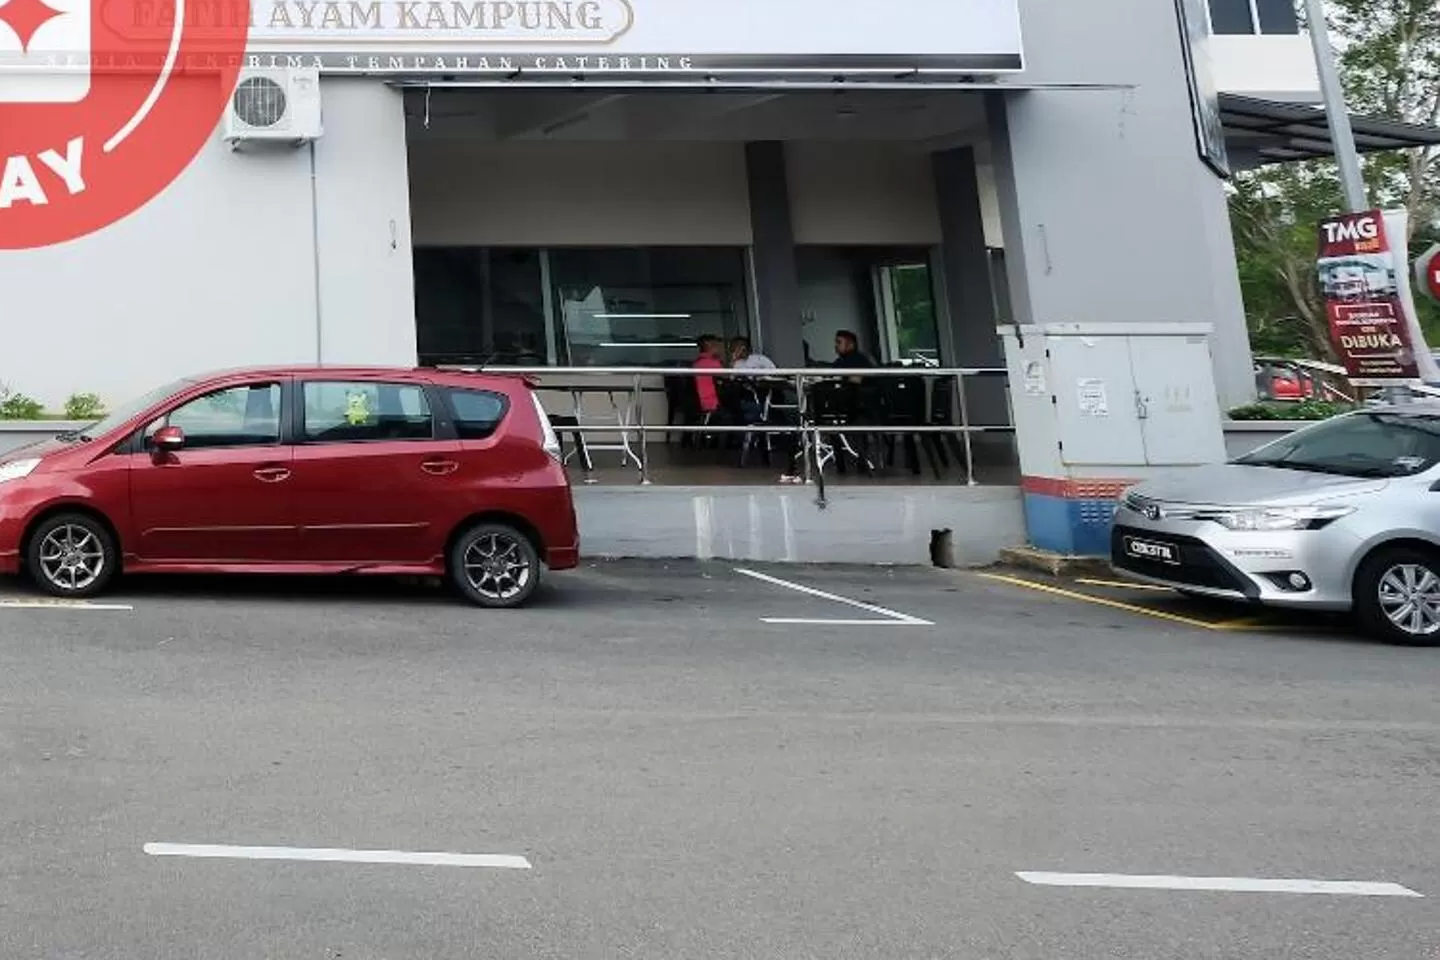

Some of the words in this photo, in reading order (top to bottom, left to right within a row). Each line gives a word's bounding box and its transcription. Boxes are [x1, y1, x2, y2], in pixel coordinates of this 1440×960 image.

[269, 0, 382, 29] AYAM
[396, 0, 603, 30] KAMPUNG
[535, 54, 693, 70] CATERING
[1323, 218, 1378, 242] TMG
[1340, 334, 1403, 349] DIBUKA
